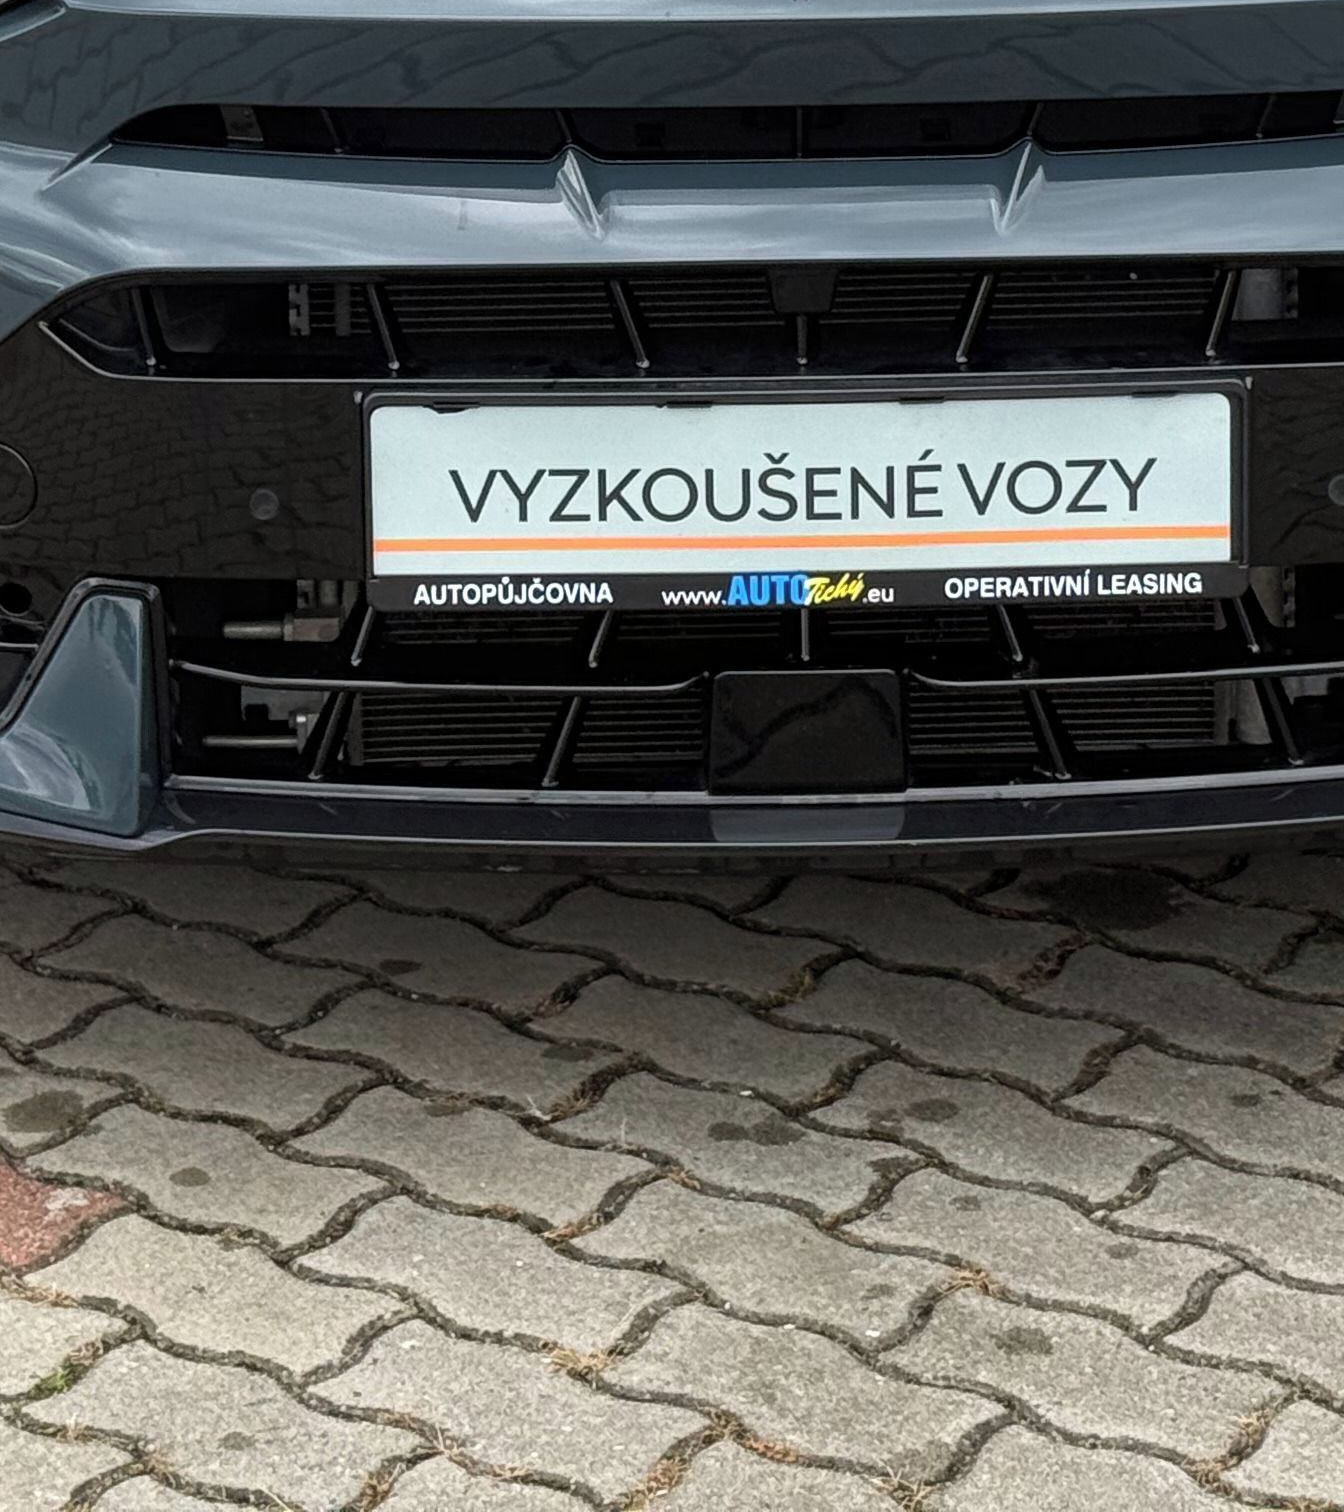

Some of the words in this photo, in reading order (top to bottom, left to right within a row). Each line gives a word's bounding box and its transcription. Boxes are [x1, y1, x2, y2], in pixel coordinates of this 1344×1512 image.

[448, 449, 943, 522] VYZKOUŠENÉ
[957, 457, 1158, 516] VOZY
[413, 575, 614, 606] AUTOPŮJČOVNA
[943, 568, 1092, 599] OPERATIVNÍ
[1096, 571, 1203, 596] LEASING
